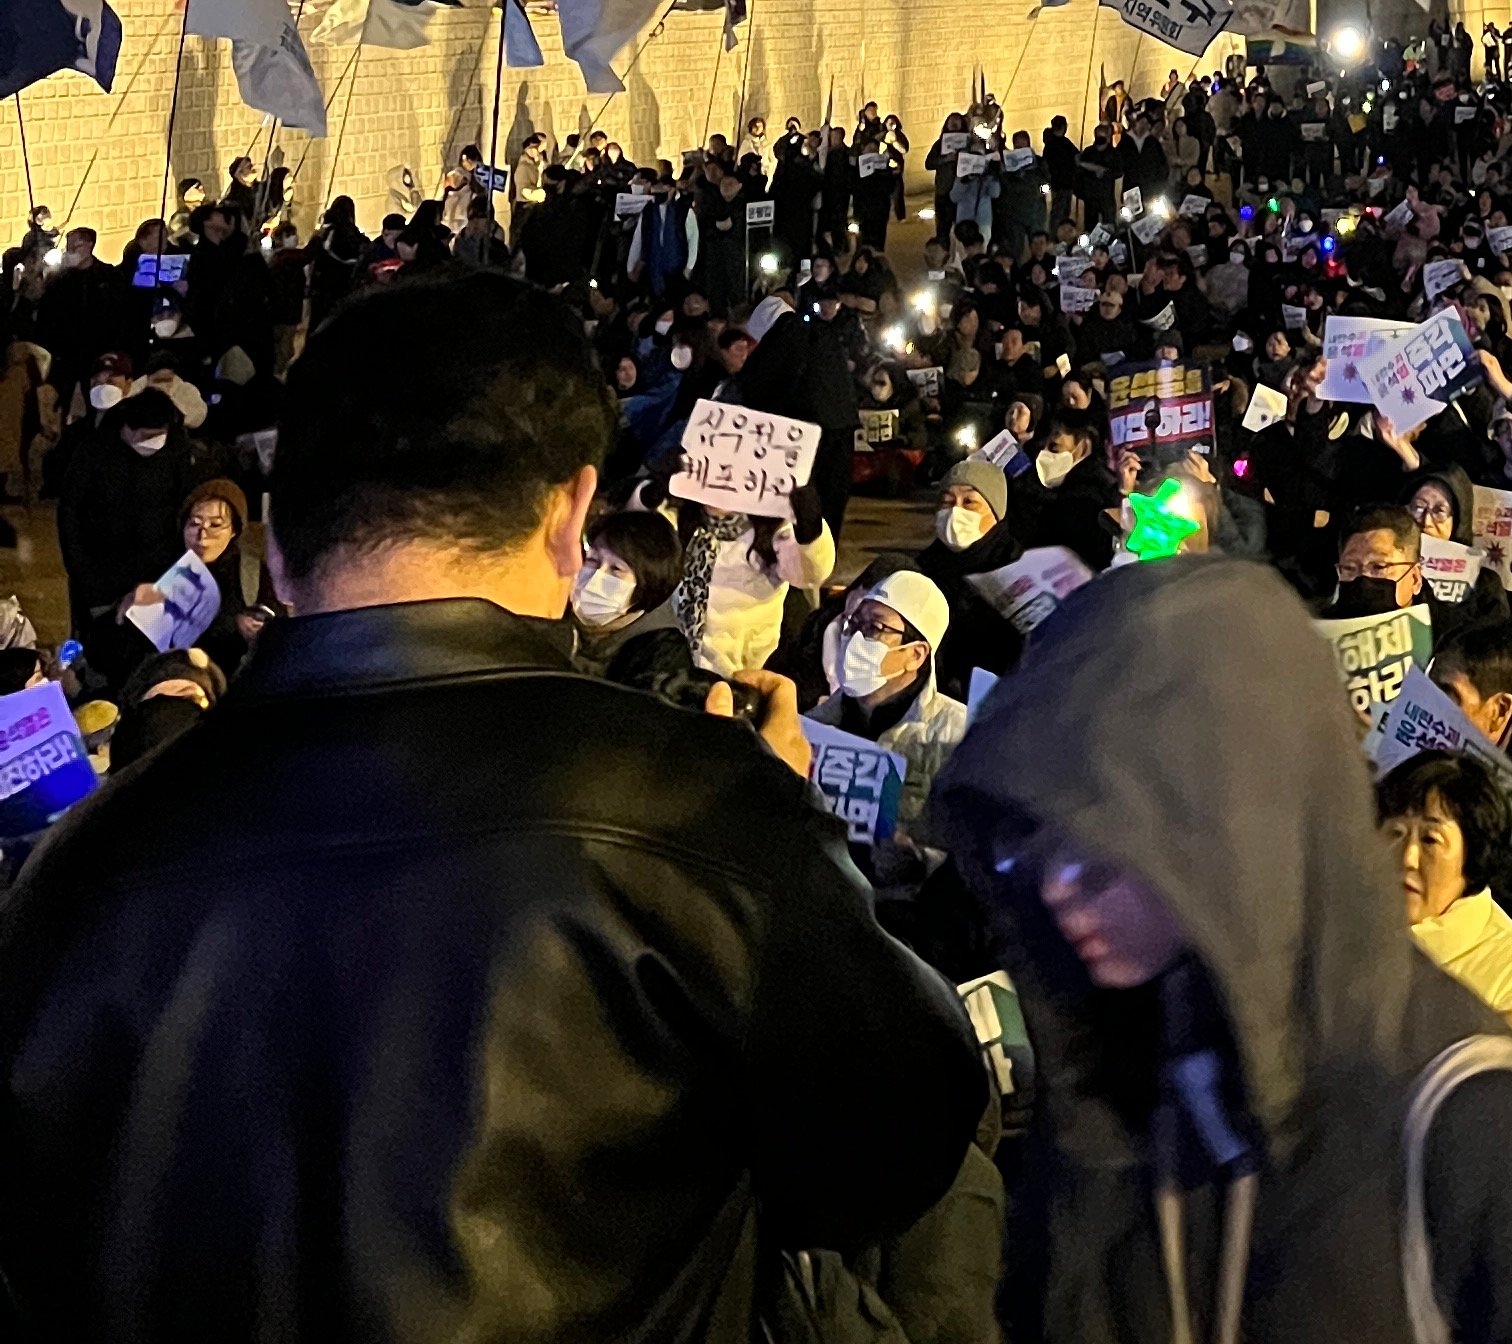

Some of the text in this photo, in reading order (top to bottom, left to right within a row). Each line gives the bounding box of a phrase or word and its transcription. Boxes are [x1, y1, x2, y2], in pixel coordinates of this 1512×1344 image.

[1404, 317, 1454, 369] 즉각
[1416, 343, 1466, 396] 파면
[1337, 614, 1414, 672] 해체
[1405, 701, 1462, 747] 내란수괴
[819, 745, 891, 795] 즉각
